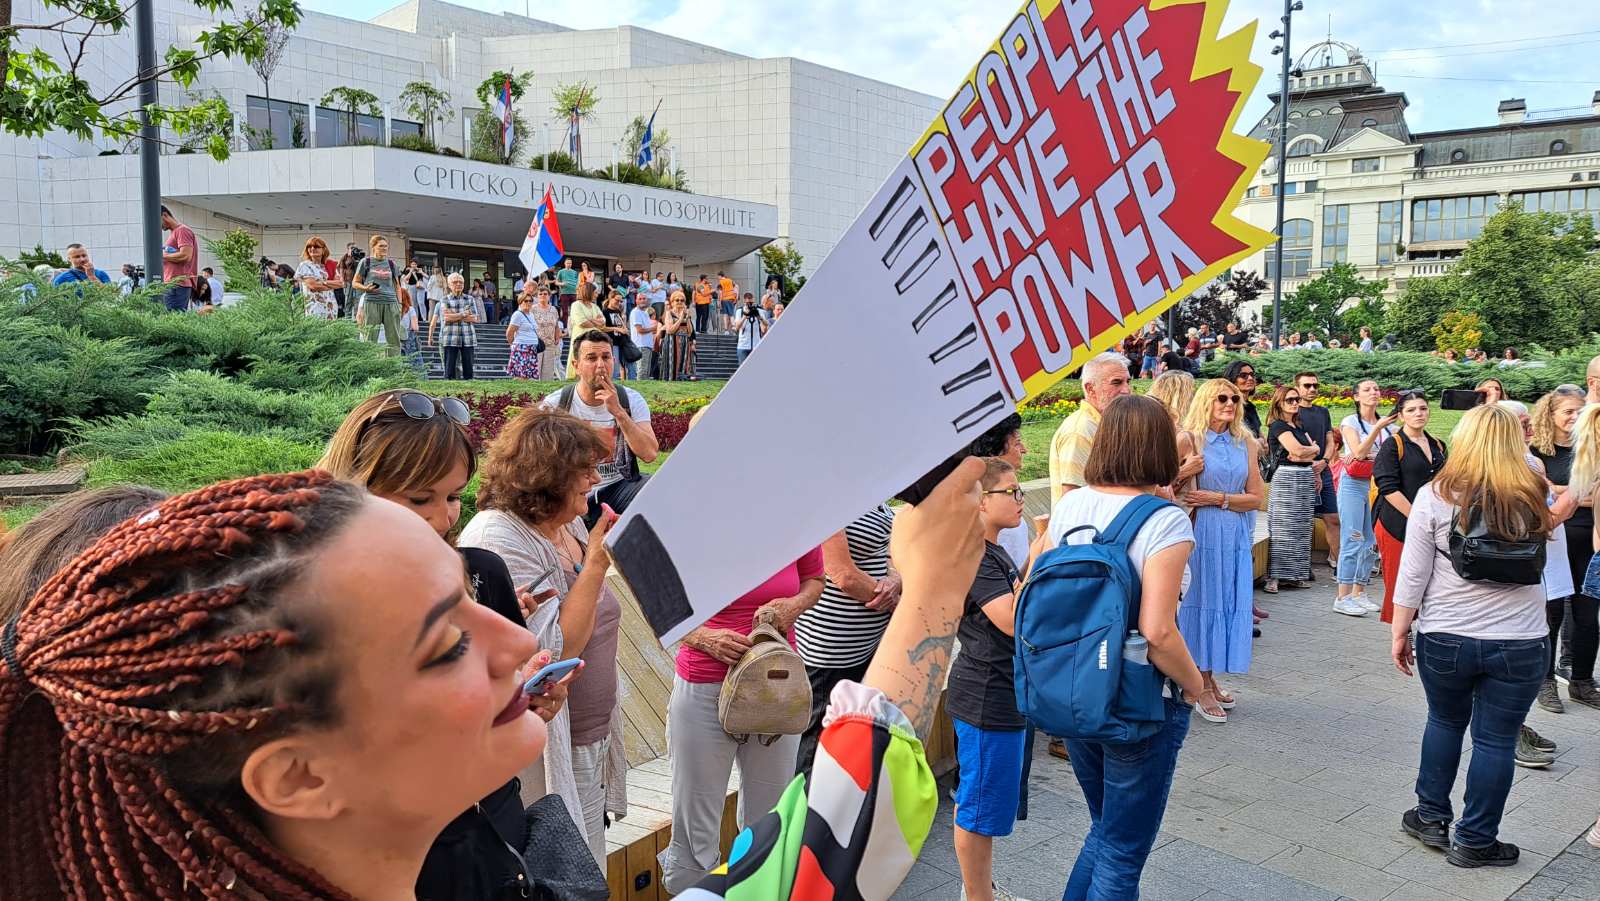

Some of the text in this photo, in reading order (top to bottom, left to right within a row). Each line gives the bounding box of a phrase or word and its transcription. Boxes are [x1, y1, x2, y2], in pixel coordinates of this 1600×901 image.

[414, 164, 756, 228] СРПСКО НАРОДНО ПОЗОРИШТЕ
[913, 0, 1104, 224] PEOPLE
[943, 5, 1177, 302] HAVE THE
[976, 136, 1208, 402] POWER
[1098, 640, 1107, 669] THULE
